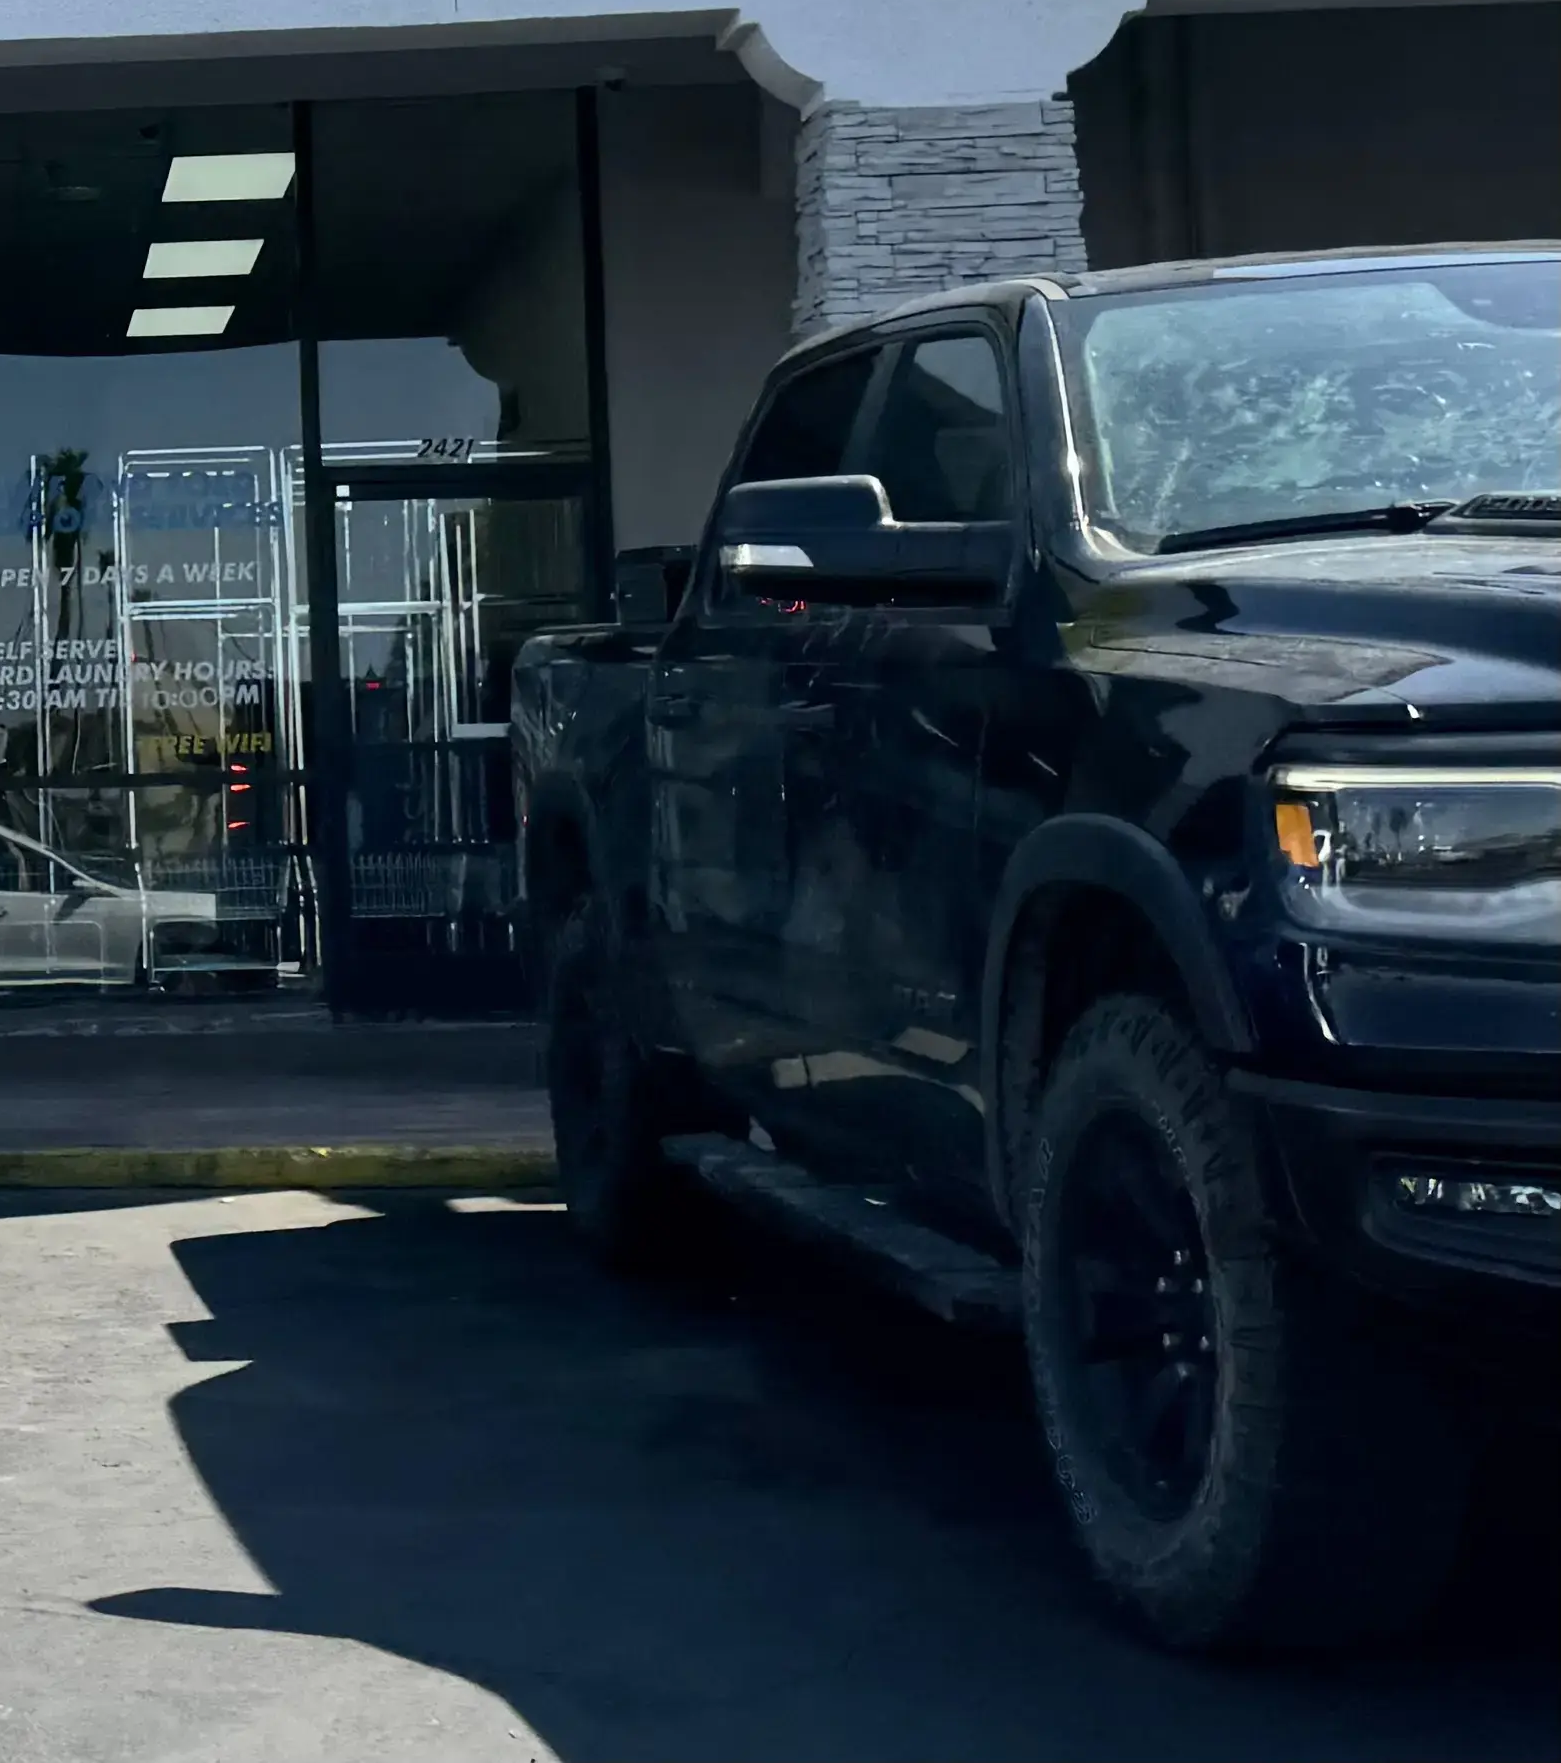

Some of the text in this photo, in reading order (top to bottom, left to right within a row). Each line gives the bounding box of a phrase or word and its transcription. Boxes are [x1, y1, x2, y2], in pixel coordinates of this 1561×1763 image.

[416, 438, 475, 459] 2421
[60, 566, 74, 586] 7
[83, 564, 150, 586] DAYS
[156, 563, 176, 584] A
[183, 560, 256, 583] WEEK
[41, 638, 119, 661] SERVE
[42, 660, 169, 685] LAUNDRY
[44, 687, 87, 710] AM
